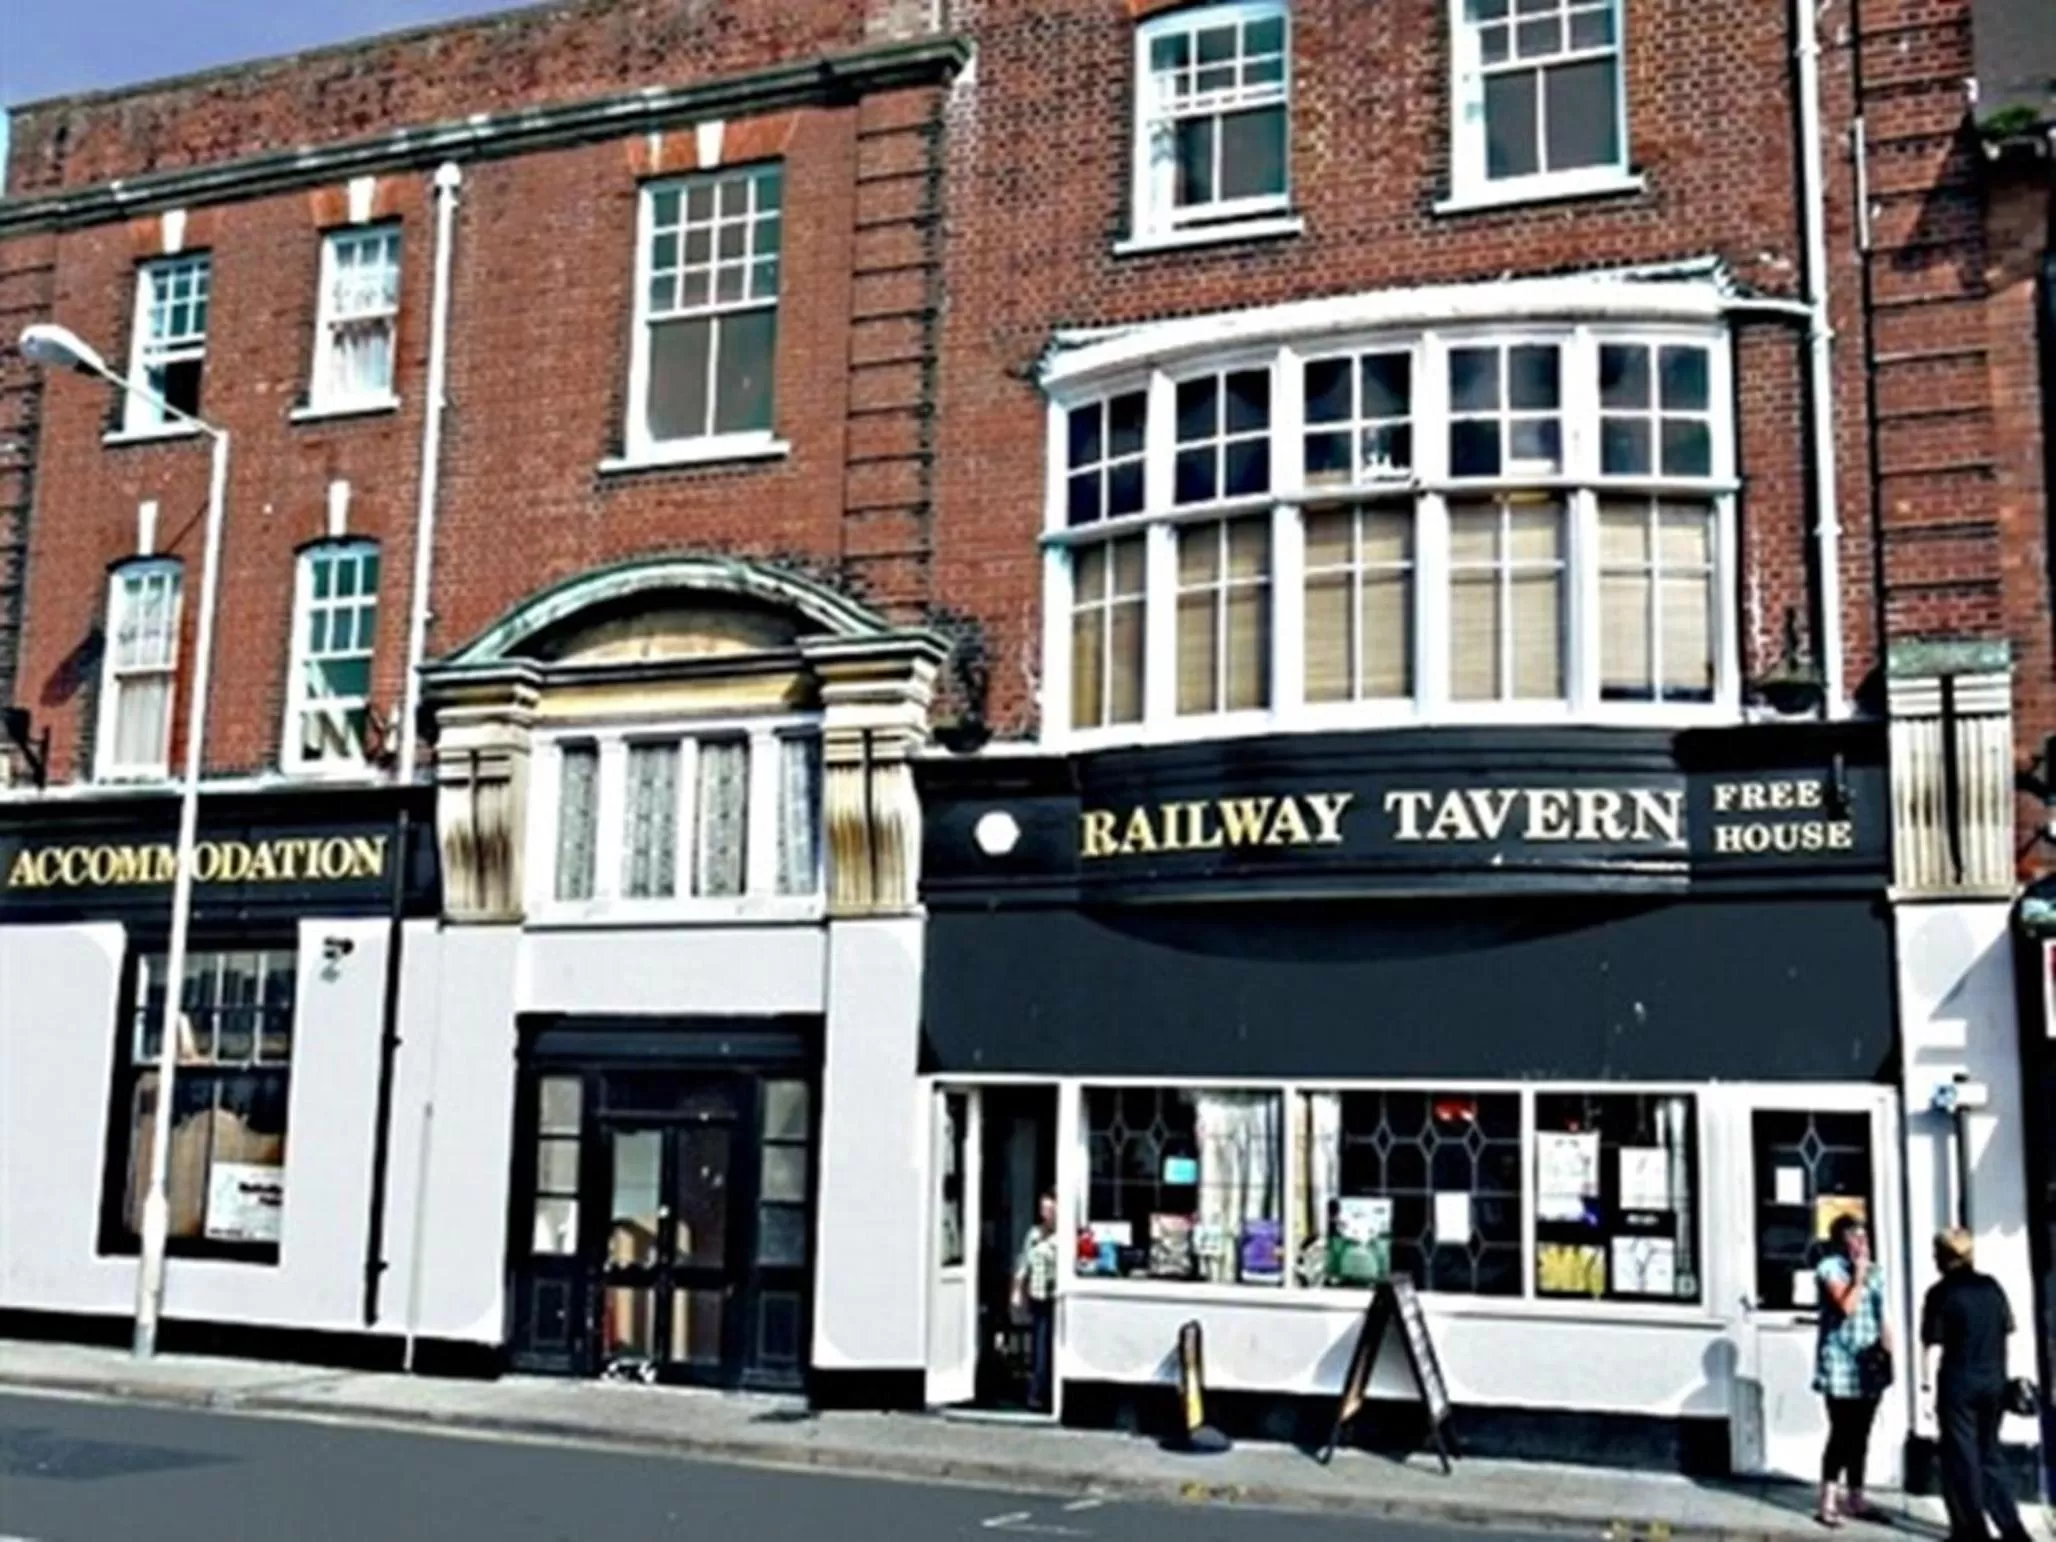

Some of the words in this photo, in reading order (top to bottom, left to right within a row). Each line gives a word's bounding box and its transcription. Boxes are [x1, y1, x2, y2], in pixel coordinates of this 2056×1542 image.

[1713, 780, 1823, 812] FREE
[1079, 792, 1353, 858] RAILWAY
[1384, 788, 1688, 850] TAVERN
[1714, 821, 1853, 853] HOUSE
